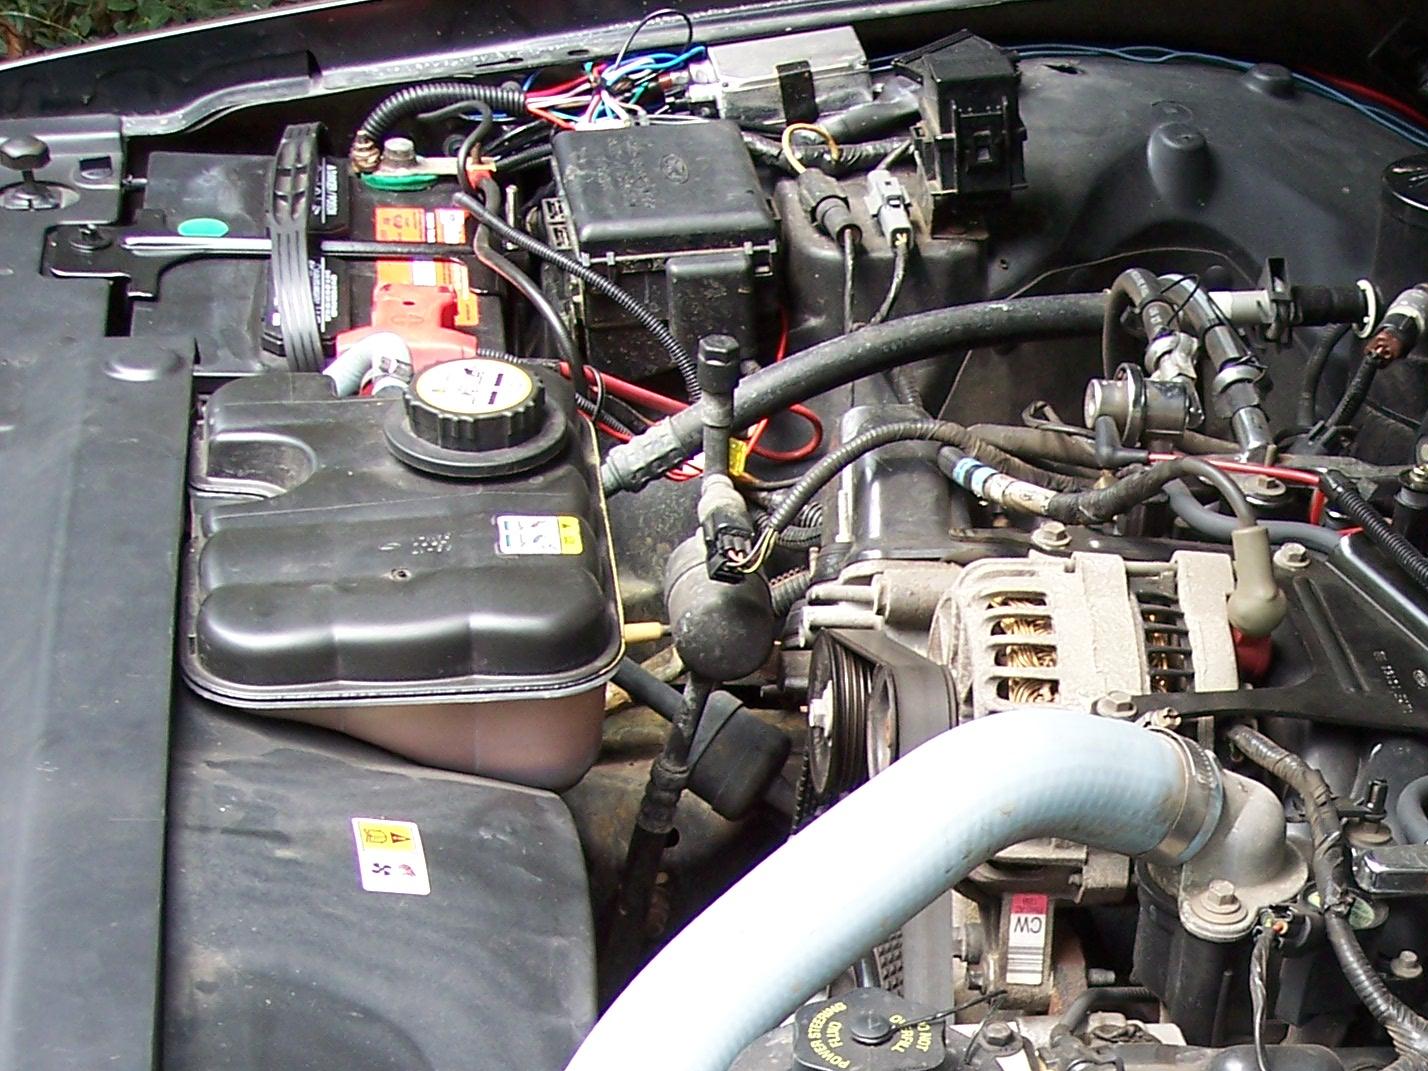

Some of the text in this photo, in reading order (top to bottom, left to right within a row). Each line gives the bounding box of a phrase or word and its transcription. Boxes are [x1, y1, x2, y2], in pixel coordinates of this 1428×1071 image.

[1014, 916, 1043, 934] CW
[807, 1001, 850, 1069] POWER STEERING
[826, 1020, 843, 1048] FLUID
[915, 1031, 932, 1052] NOT
